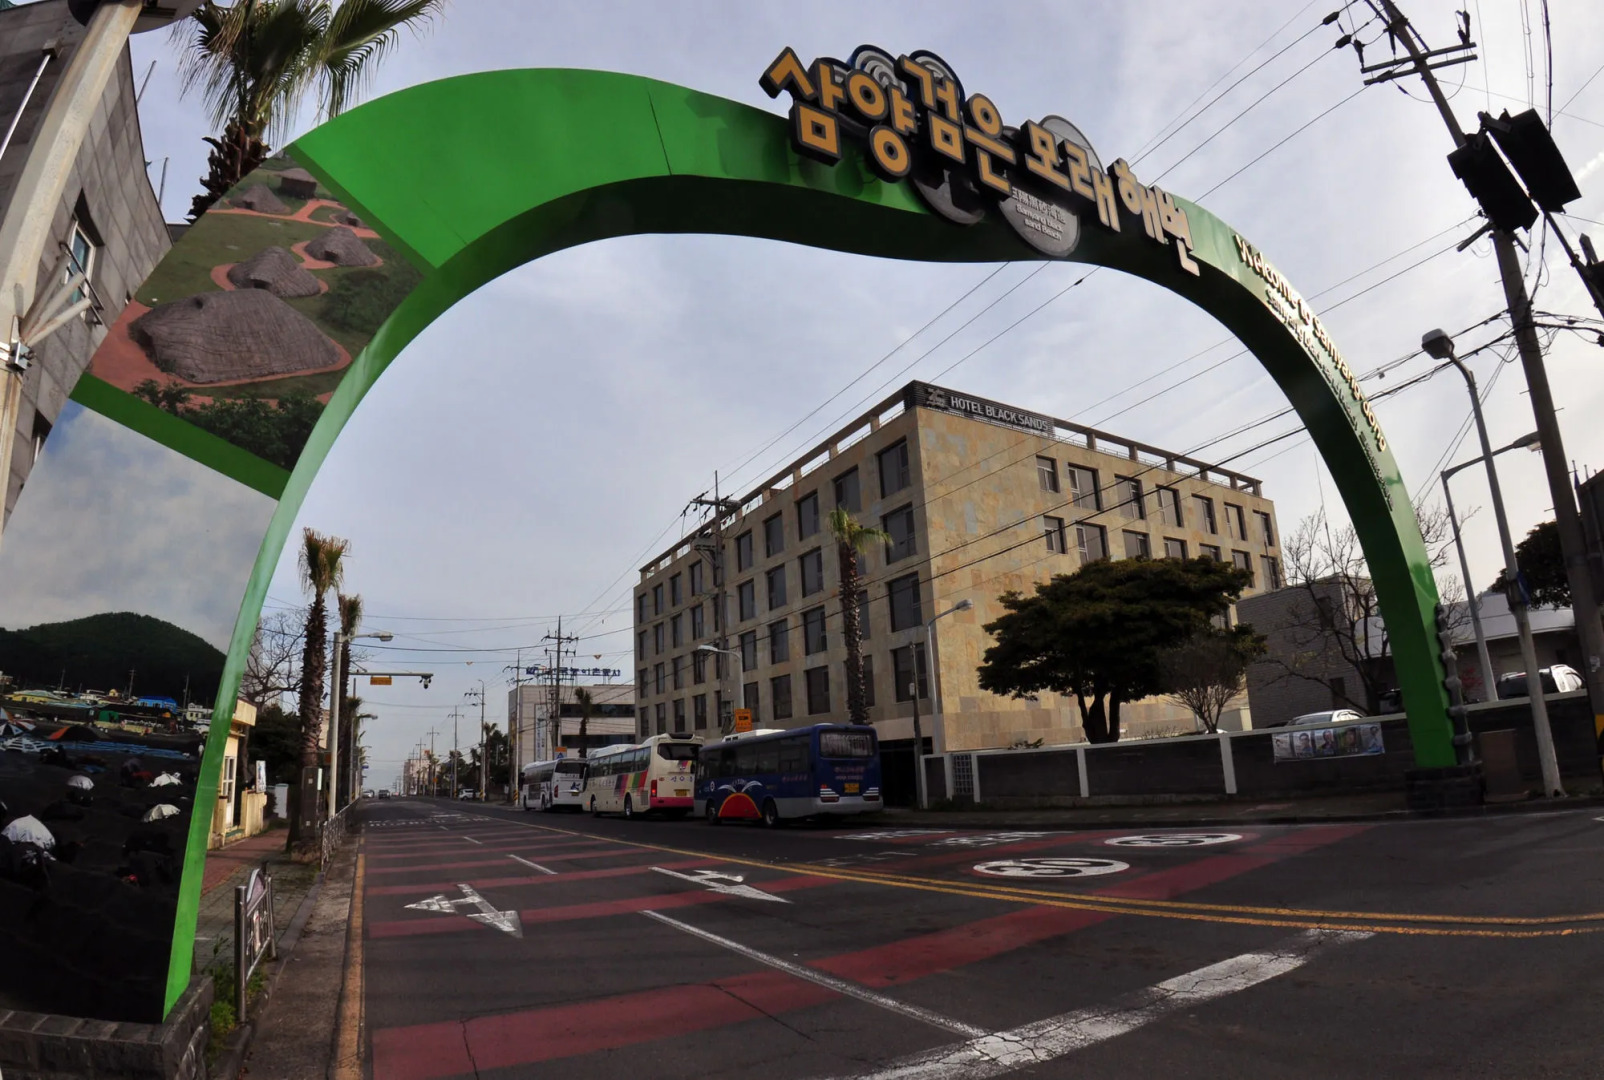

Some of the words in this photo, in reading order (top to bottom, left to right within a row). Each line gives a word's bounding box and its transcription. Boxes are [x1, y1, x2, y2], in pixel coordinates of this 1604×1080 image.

[1233, 233, 1298, 310] Welcome
[950, 396, 984, 415] HOTEL
[985, 405, 1018, 424] BLACK
[1018, 414, 1049, 431] SANDS
